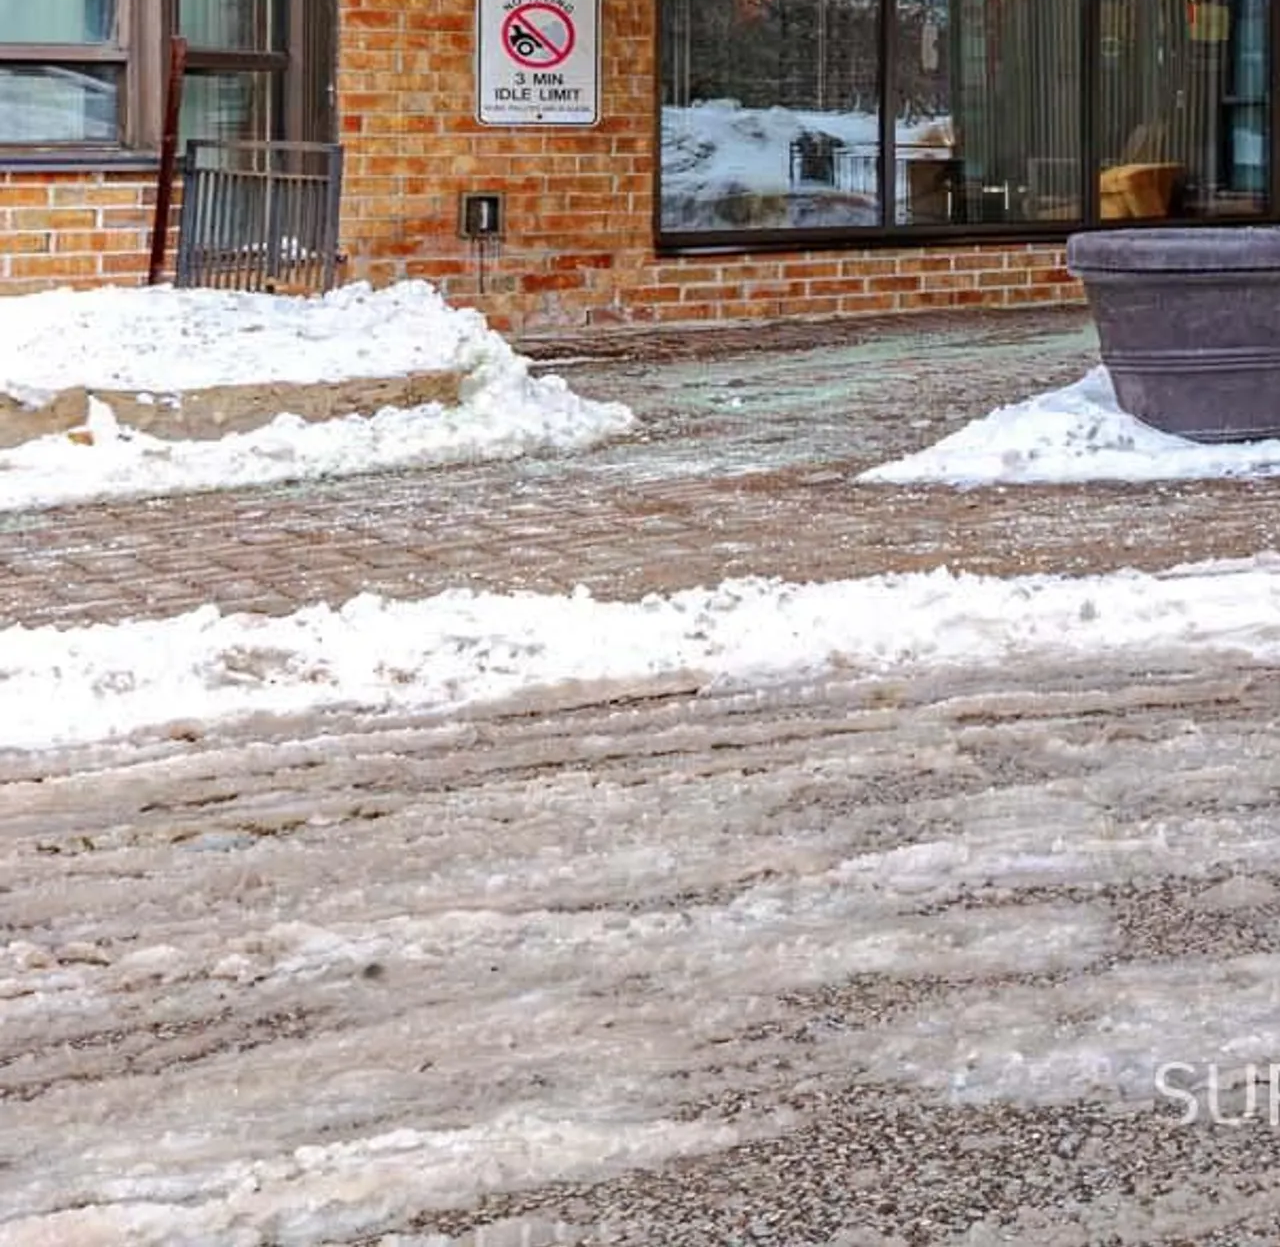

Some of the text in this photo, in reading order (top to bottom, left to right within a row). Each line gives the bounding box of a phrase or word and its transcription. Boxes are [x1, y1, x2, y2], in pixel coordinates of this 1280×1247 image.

[515, 73, 563, 85] 3 MIN
[494, 88, 581, 102] IDLE LIMIT
